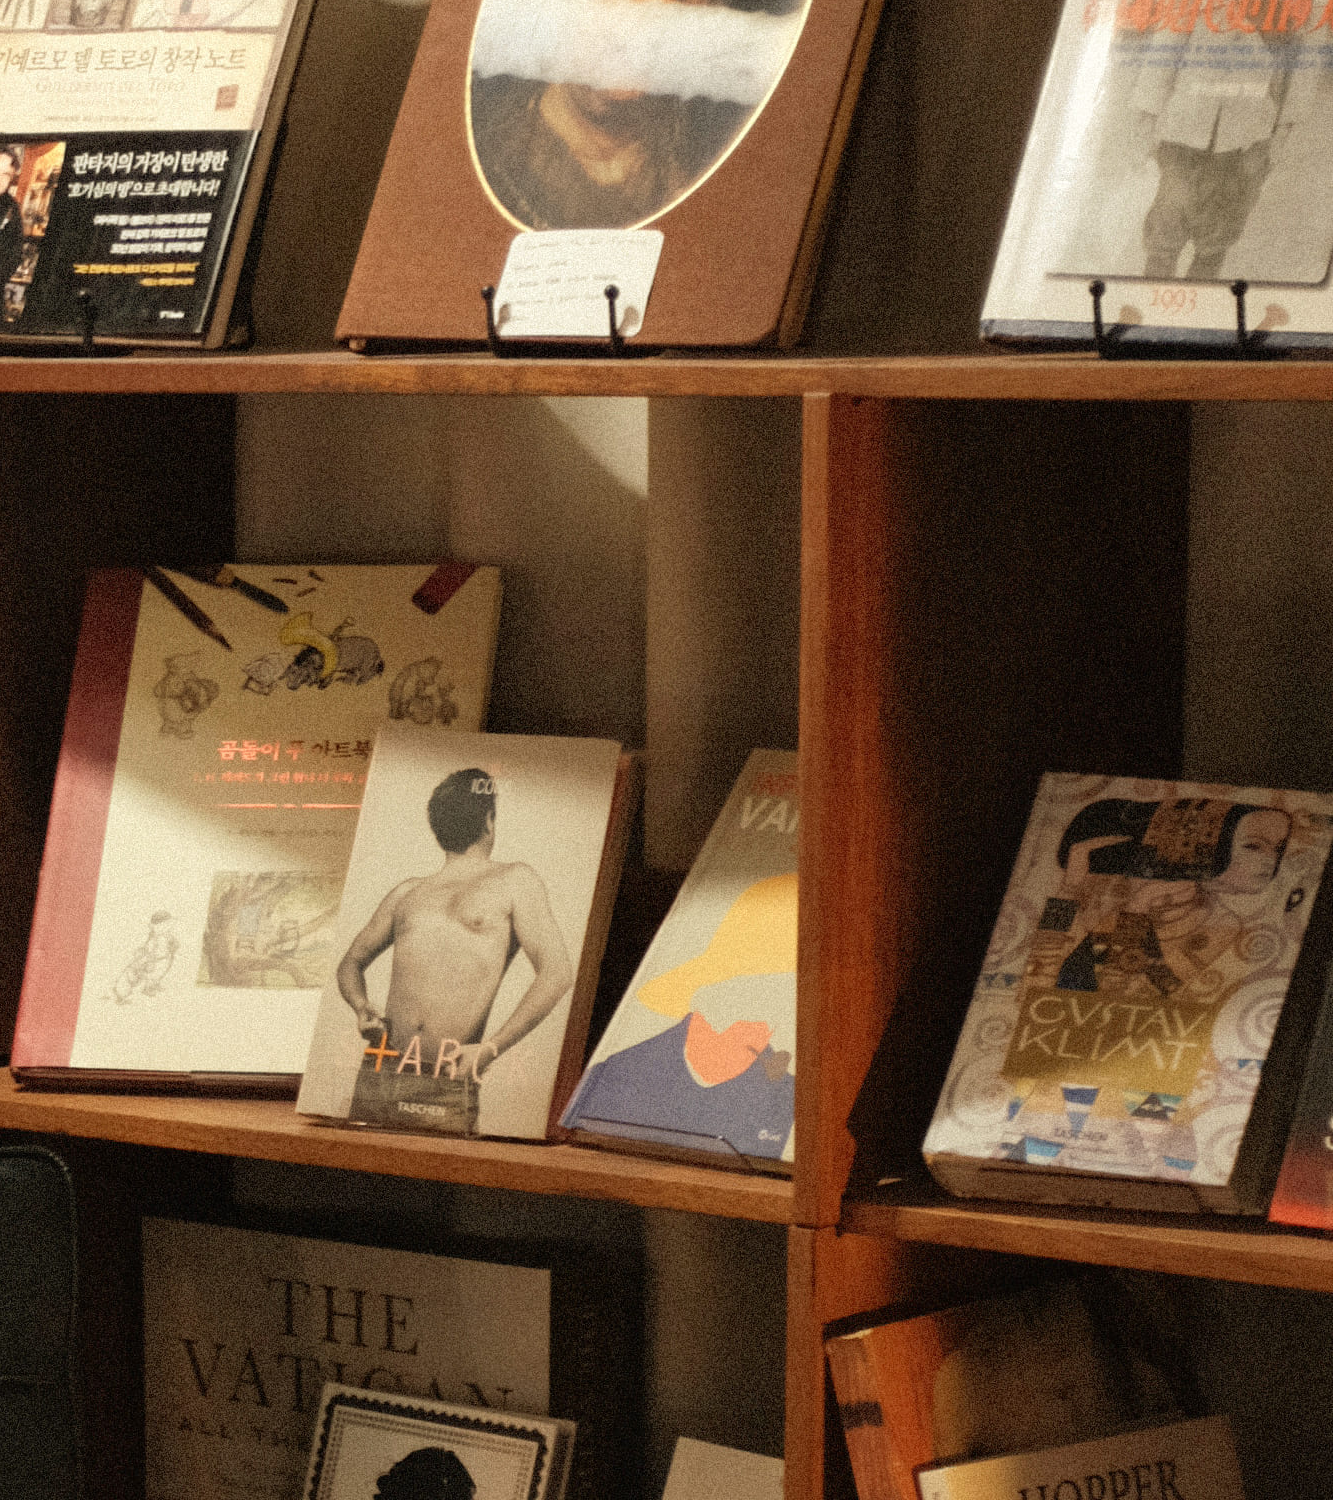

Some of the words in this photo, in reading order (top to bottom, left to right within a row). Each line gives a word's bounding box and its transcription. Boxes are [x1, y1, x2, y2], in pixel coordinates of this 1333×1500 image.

[73, 47, 93, 72] 델
[95, 47, 158, 72] 토로의
[163, 47, 203, 73] 창작
[204, 48, 247, 71] 노트
[72, 151, 133, 175] 판타지의
[134, 150, 181, 174] 거장이
[218, 739, 281, 762] 곰돌이
[1017, 1024, 1199, 1072] KLIMT
[267, 1277, 420, 1356] THE
